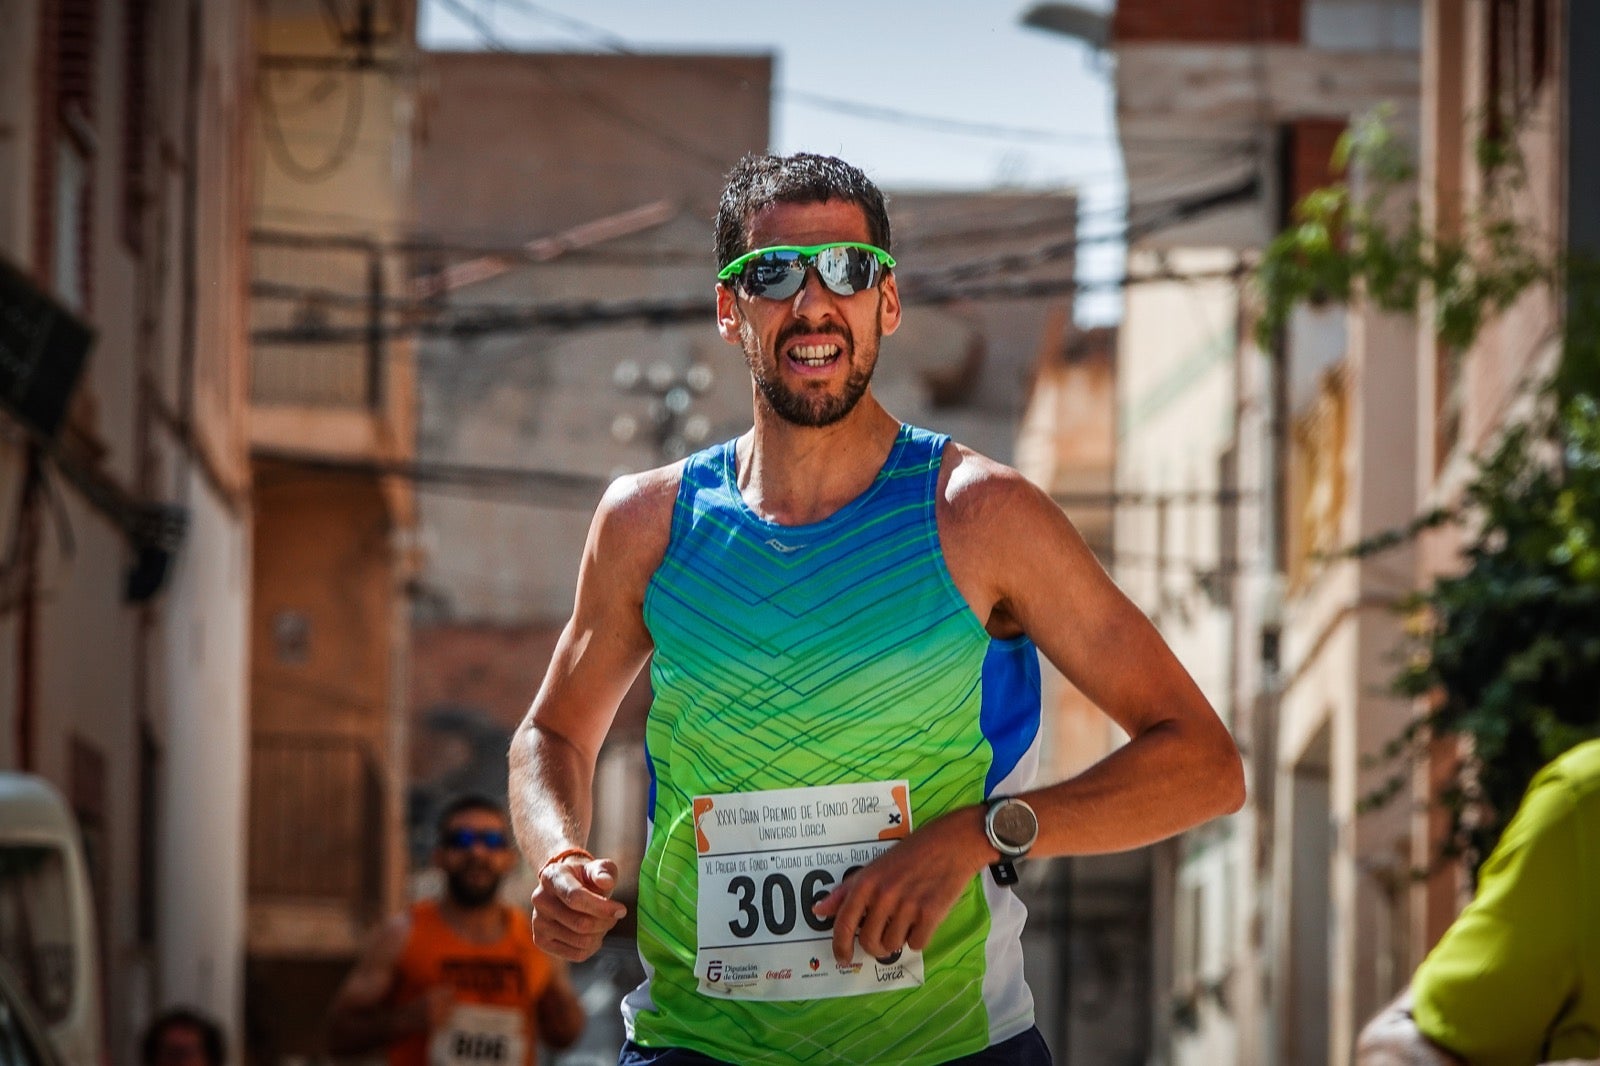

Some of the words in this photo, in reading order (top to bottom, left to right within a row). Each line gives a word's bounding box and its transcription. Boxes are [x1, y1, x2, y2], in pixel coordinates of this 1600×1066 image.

[715, 807, 737, 827] XXXV
[739, 807, 760, 825] GRAN
[762, 805, 797, 823] PREMIO
[800, 804, 813, 820] DE
[816, 800, 848, 818] FONDO
[852, 796, 880, 815] 2022
[758, 825, 797, 842] UNIVERSO
[799, 822, 826, 838] LORCA
[715, 860, 737, 874] PRUEBA
[739, 859, 747, 873] DE
[749, 857, 768, 872] FONDO
[804, 854, 814, 867] DE
[727, 865, 866, 938] 306
[724, 963, 758, 973] Diputación
[732, 972, 758, 981] Granada
[875, 963, 904, 982] Lorca
